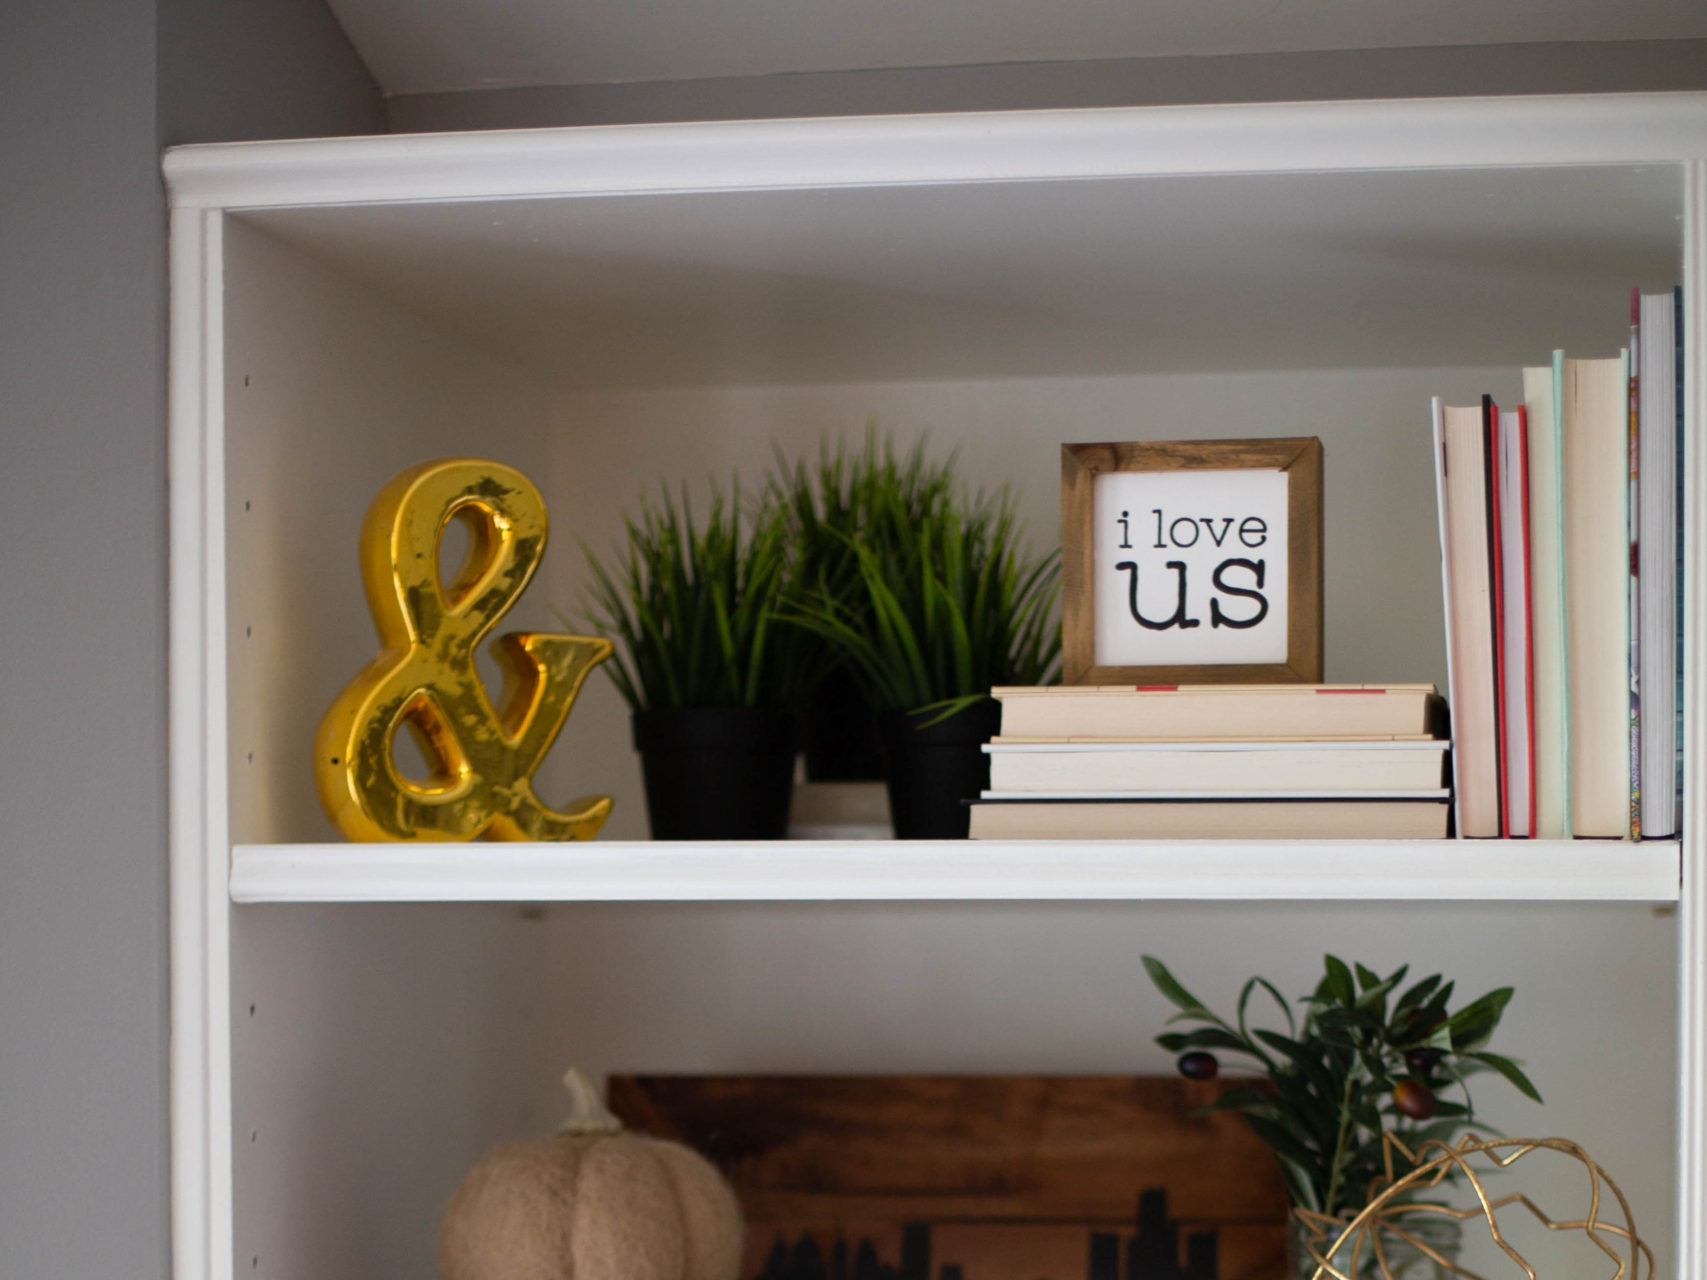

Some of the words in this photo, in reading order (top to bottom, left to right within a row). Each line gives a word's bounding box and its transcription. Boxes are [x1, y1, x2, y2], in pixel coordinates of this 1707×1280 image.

[1117, 510, 1133, 549] i
[1151, 509, 1268, 548] love
[1115, 558, 1269, 631] us
[314, 456, 614, 842] &
